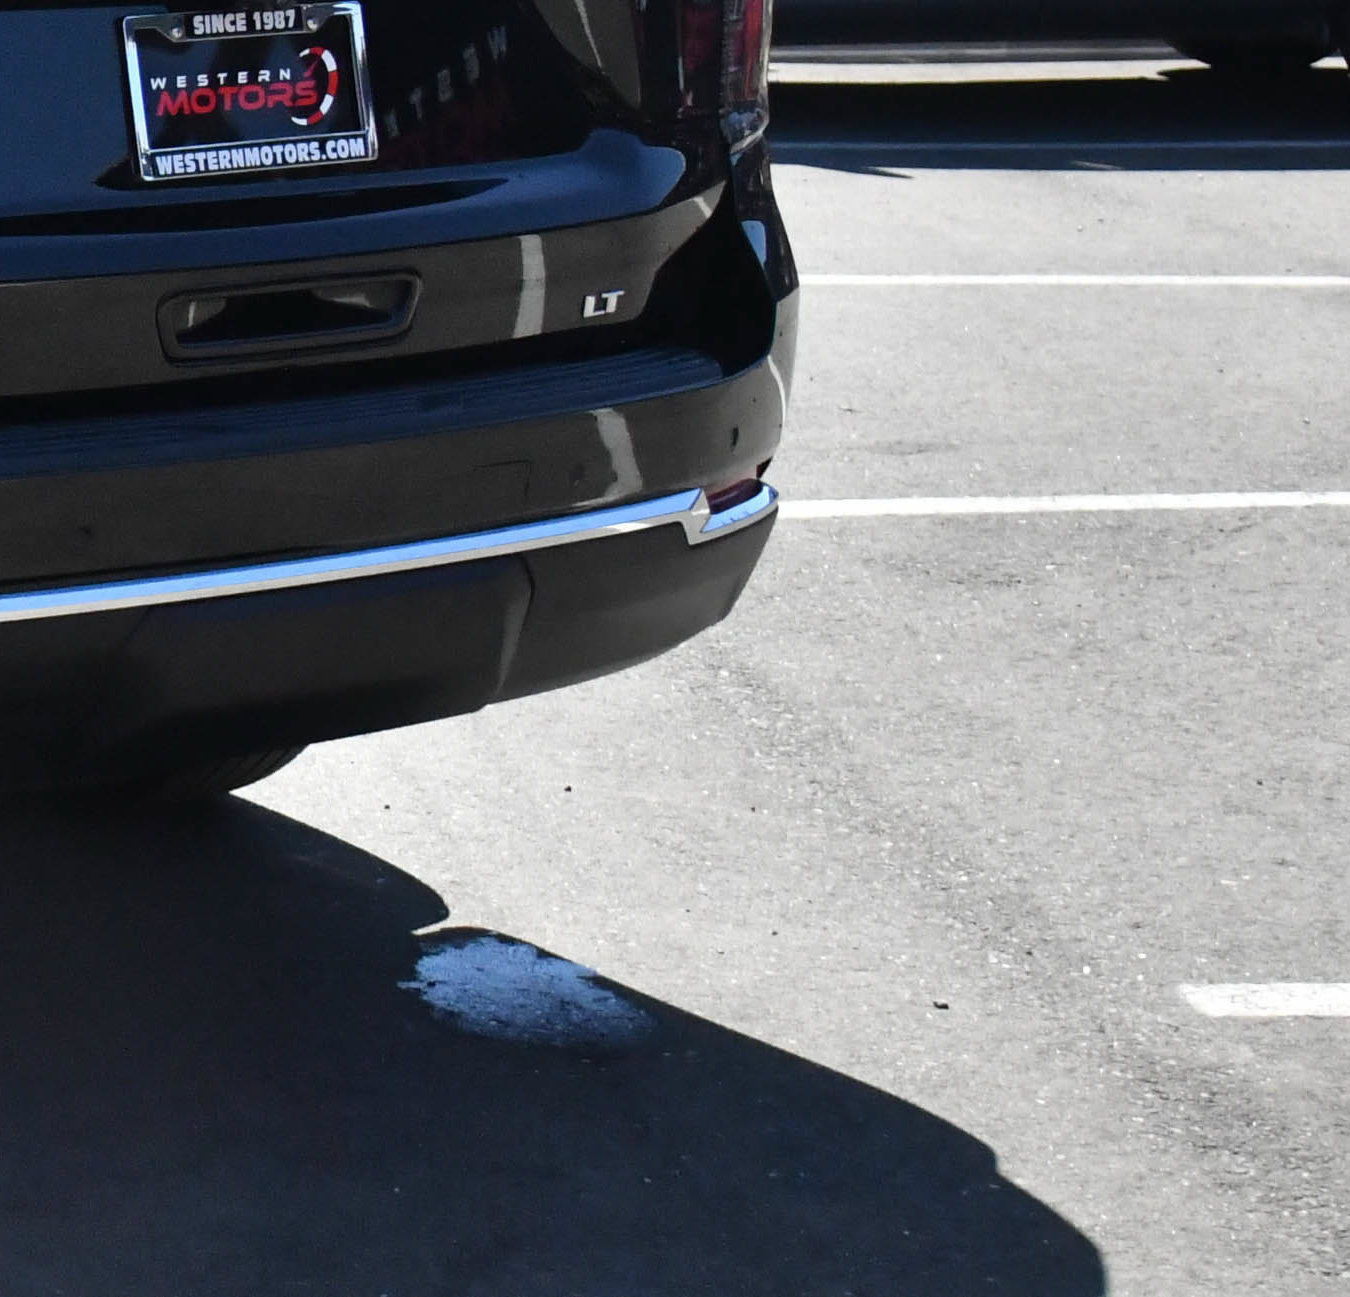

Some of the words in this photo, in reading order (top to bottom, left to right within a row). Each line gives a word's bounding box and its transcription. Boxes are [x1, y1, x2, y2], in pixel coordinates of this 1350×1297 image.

[192, 12, 247, 36] SINCE
[252, 8, 296, 32] 1987
[150, 67, 292, 91] WESTERN
[155, 79, 318, 118] MOTORS
[155, 137, 366, 176] WESTERNMOTORS.COM
[583, 289, 625, 319] LT
